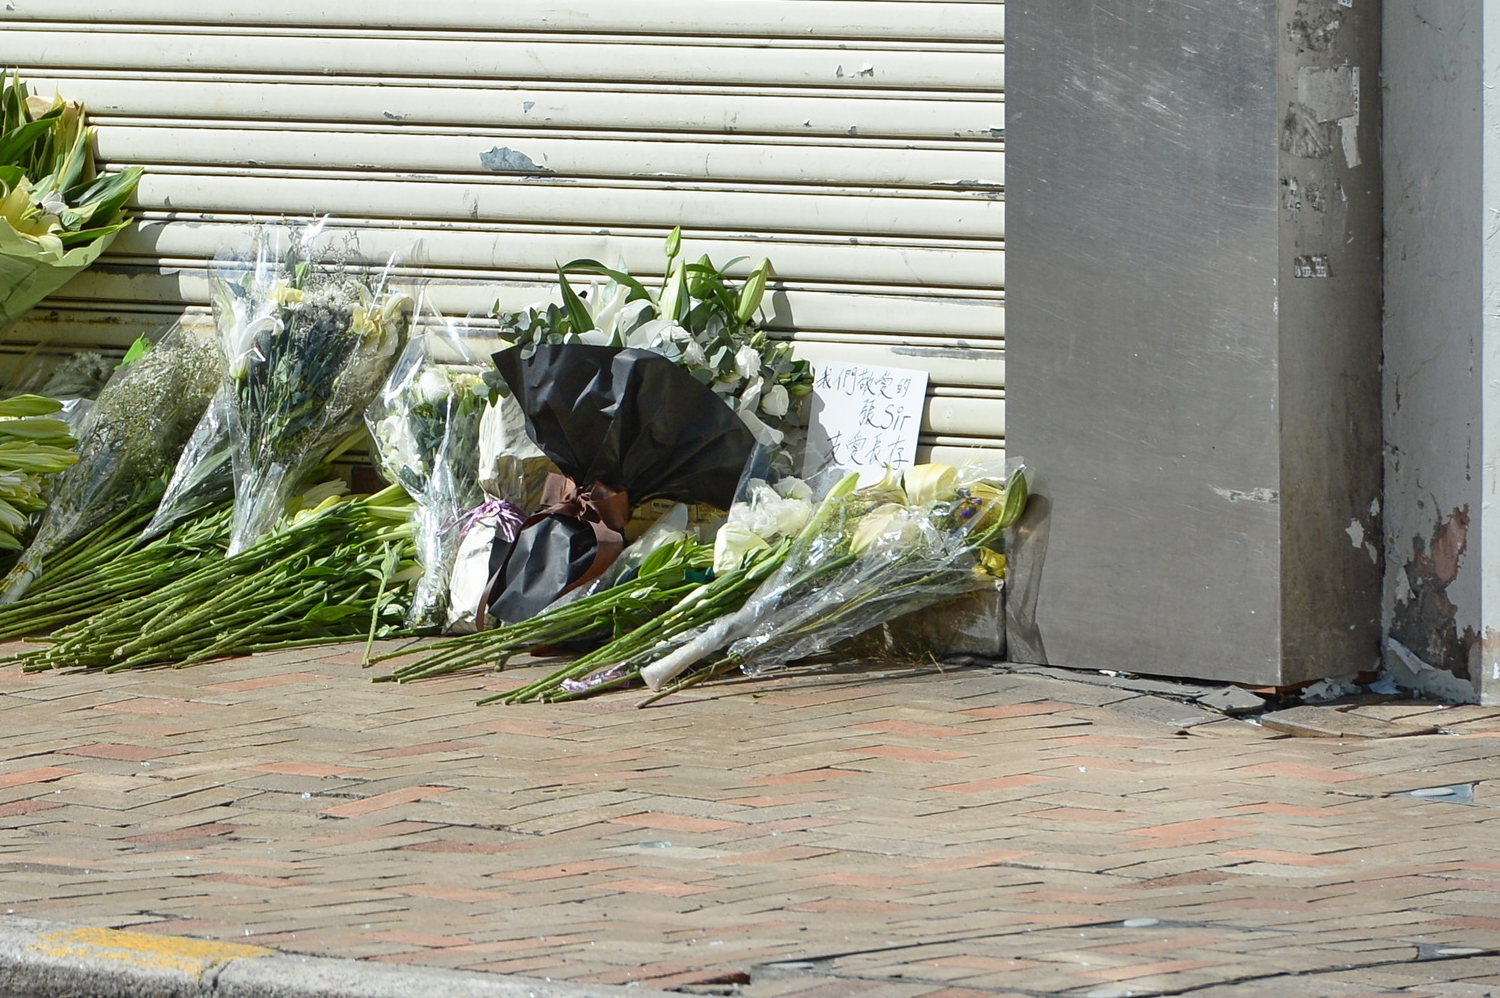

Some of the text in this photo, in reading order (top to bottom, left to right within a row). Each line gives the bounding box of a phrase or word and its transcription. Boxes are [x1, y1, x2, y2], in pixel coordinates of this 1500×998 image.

[816, 365, 912, 400] 我們敬愛的
